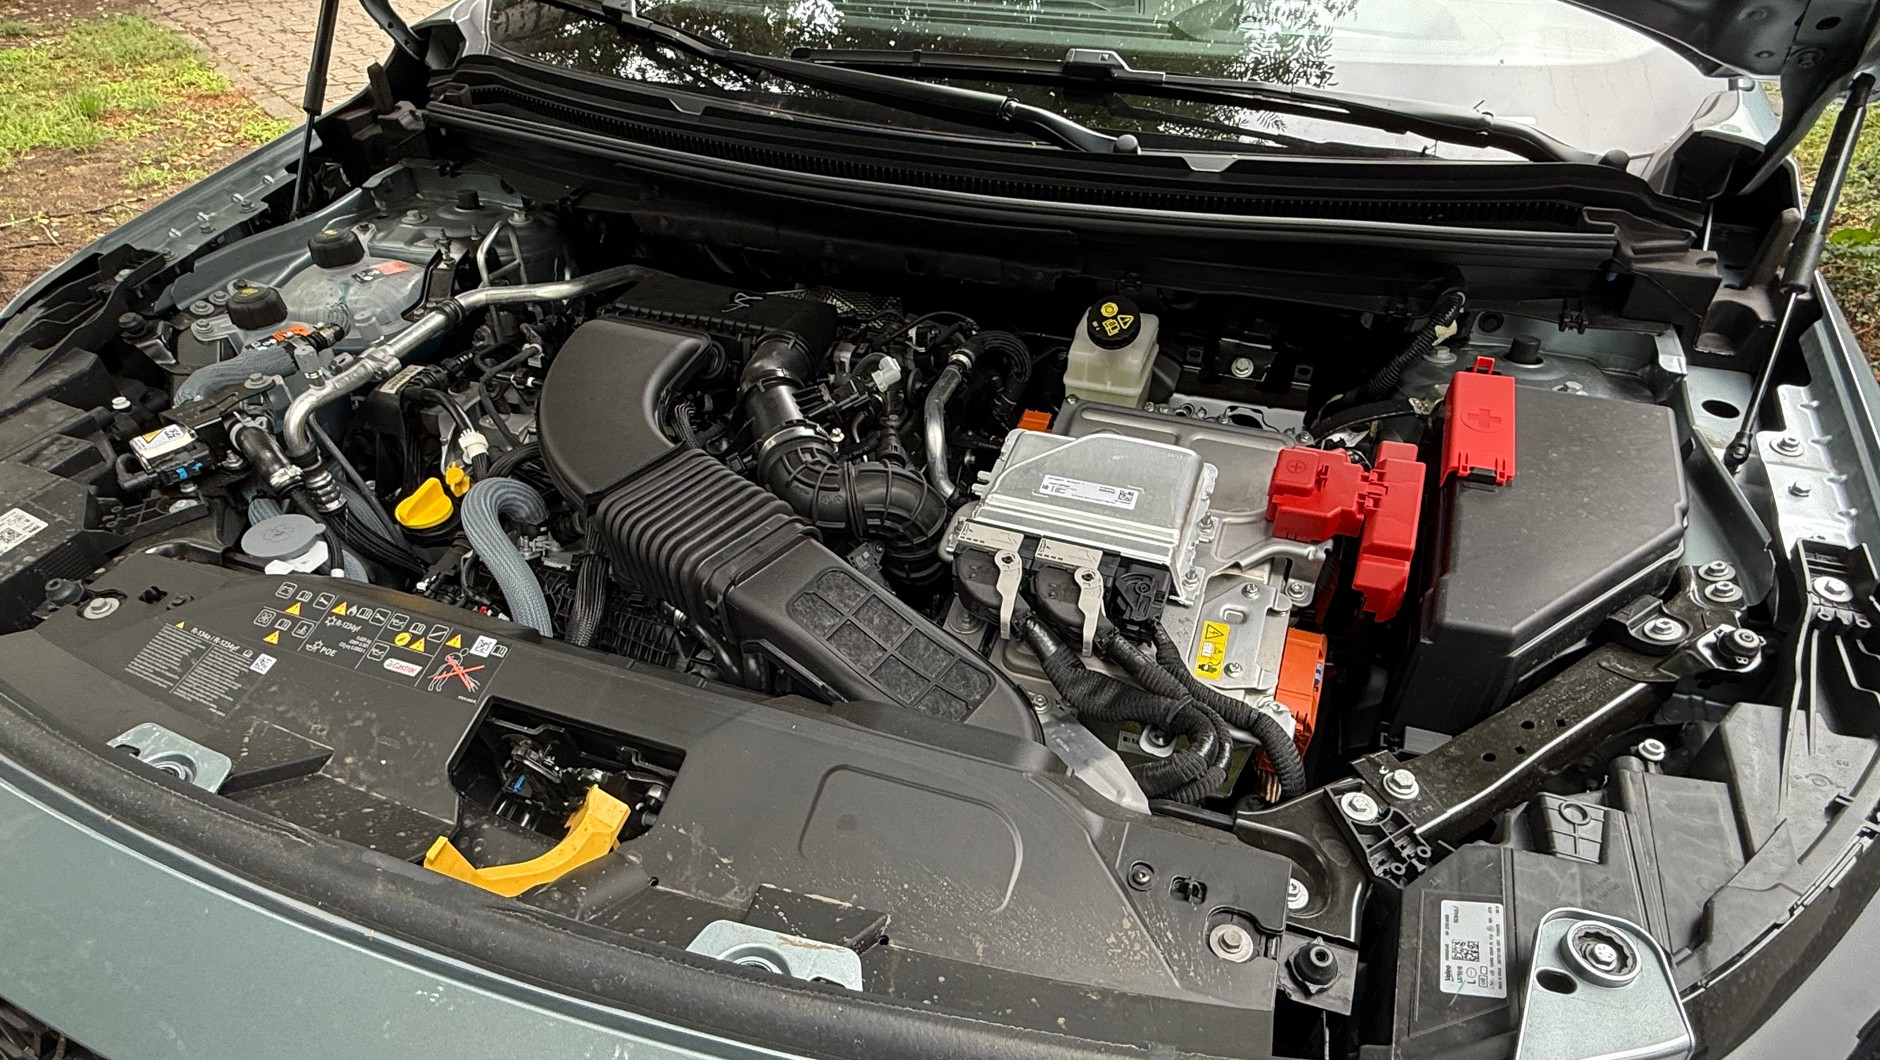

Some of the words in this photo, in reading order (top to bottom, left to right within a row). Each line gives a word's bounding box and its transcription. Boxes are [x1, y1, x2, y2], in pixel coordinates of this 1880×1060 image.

[336, 620, 362, 633] R-1234yf
[191, 627, 212, 640] R-134a
[213, 636, 240, 652] R-1234yf
[319, 645, 337, 658] POE
[391, 661, 415, 675] Castrol
[1444, 965, 1452, 981] Valeo
